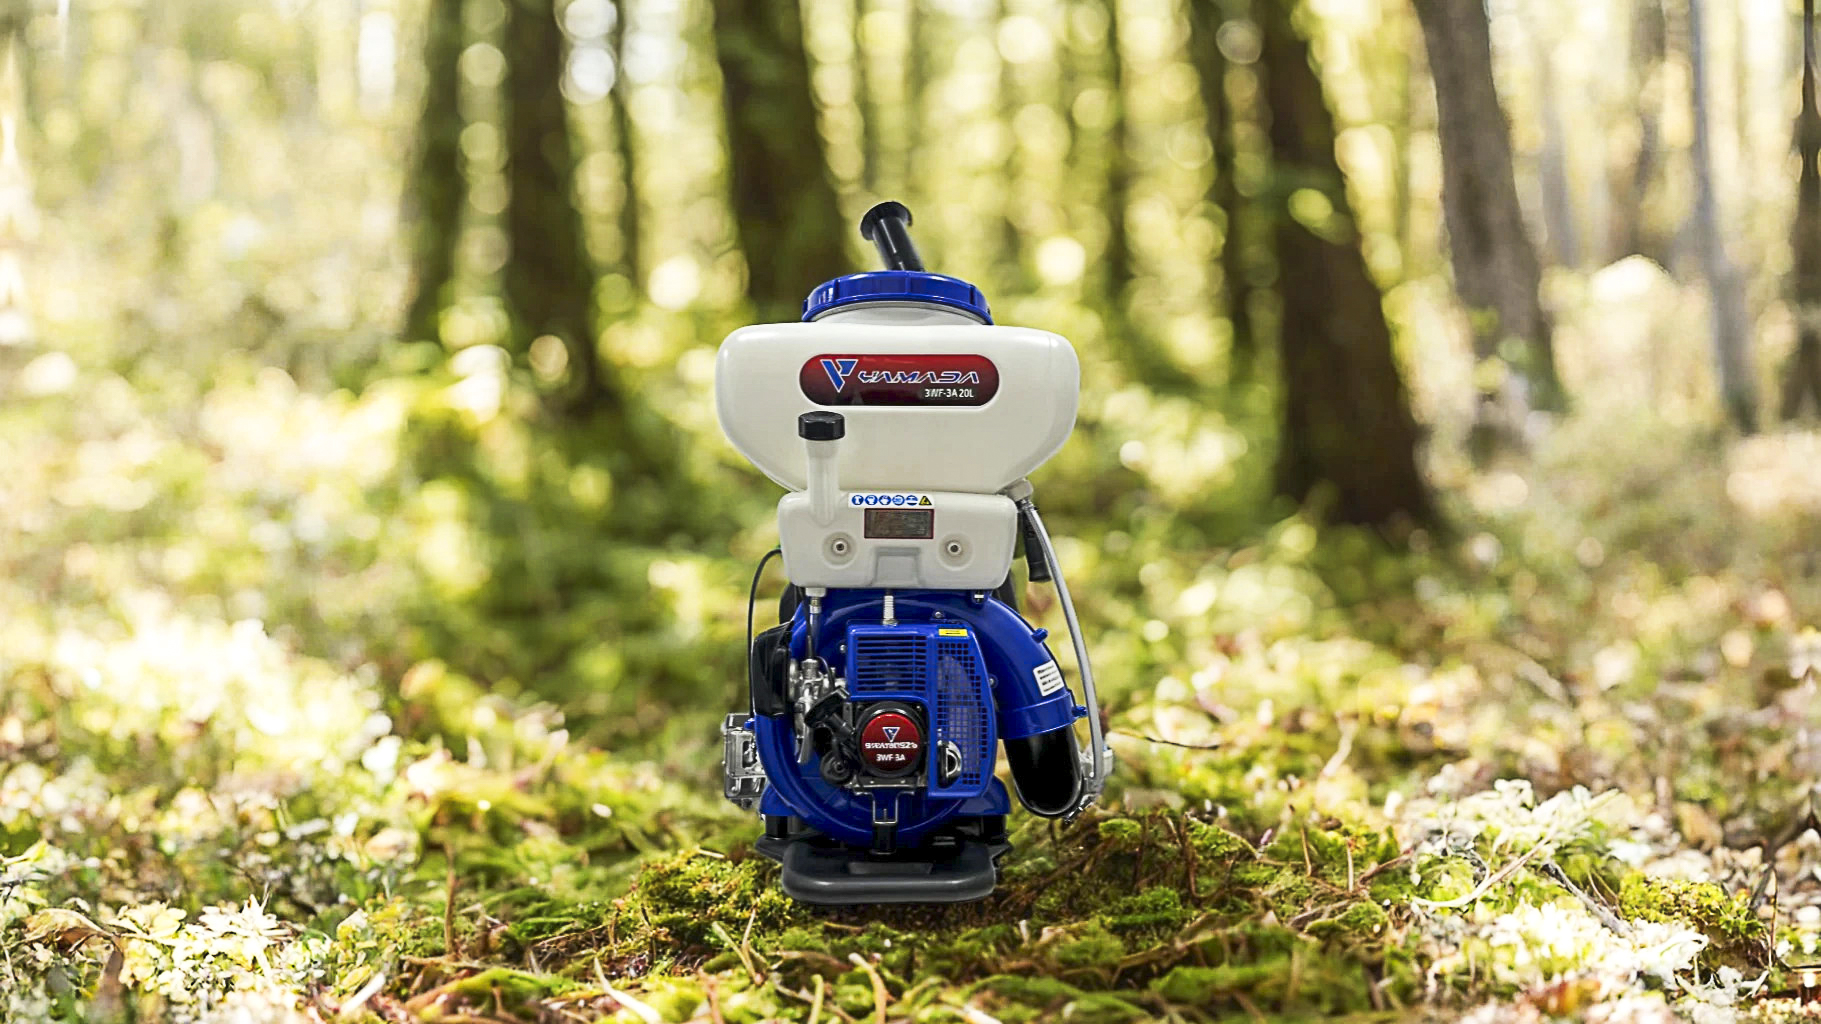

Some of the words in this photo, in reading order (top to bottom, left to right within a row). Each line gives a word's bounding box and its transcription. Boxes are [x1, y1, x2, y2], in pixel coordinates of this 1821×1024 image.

[858, 371, 980, 384] YAMADA
[924, 388, 958, 398] 3WF-3A
[958, 388, 975, 398] 20L
